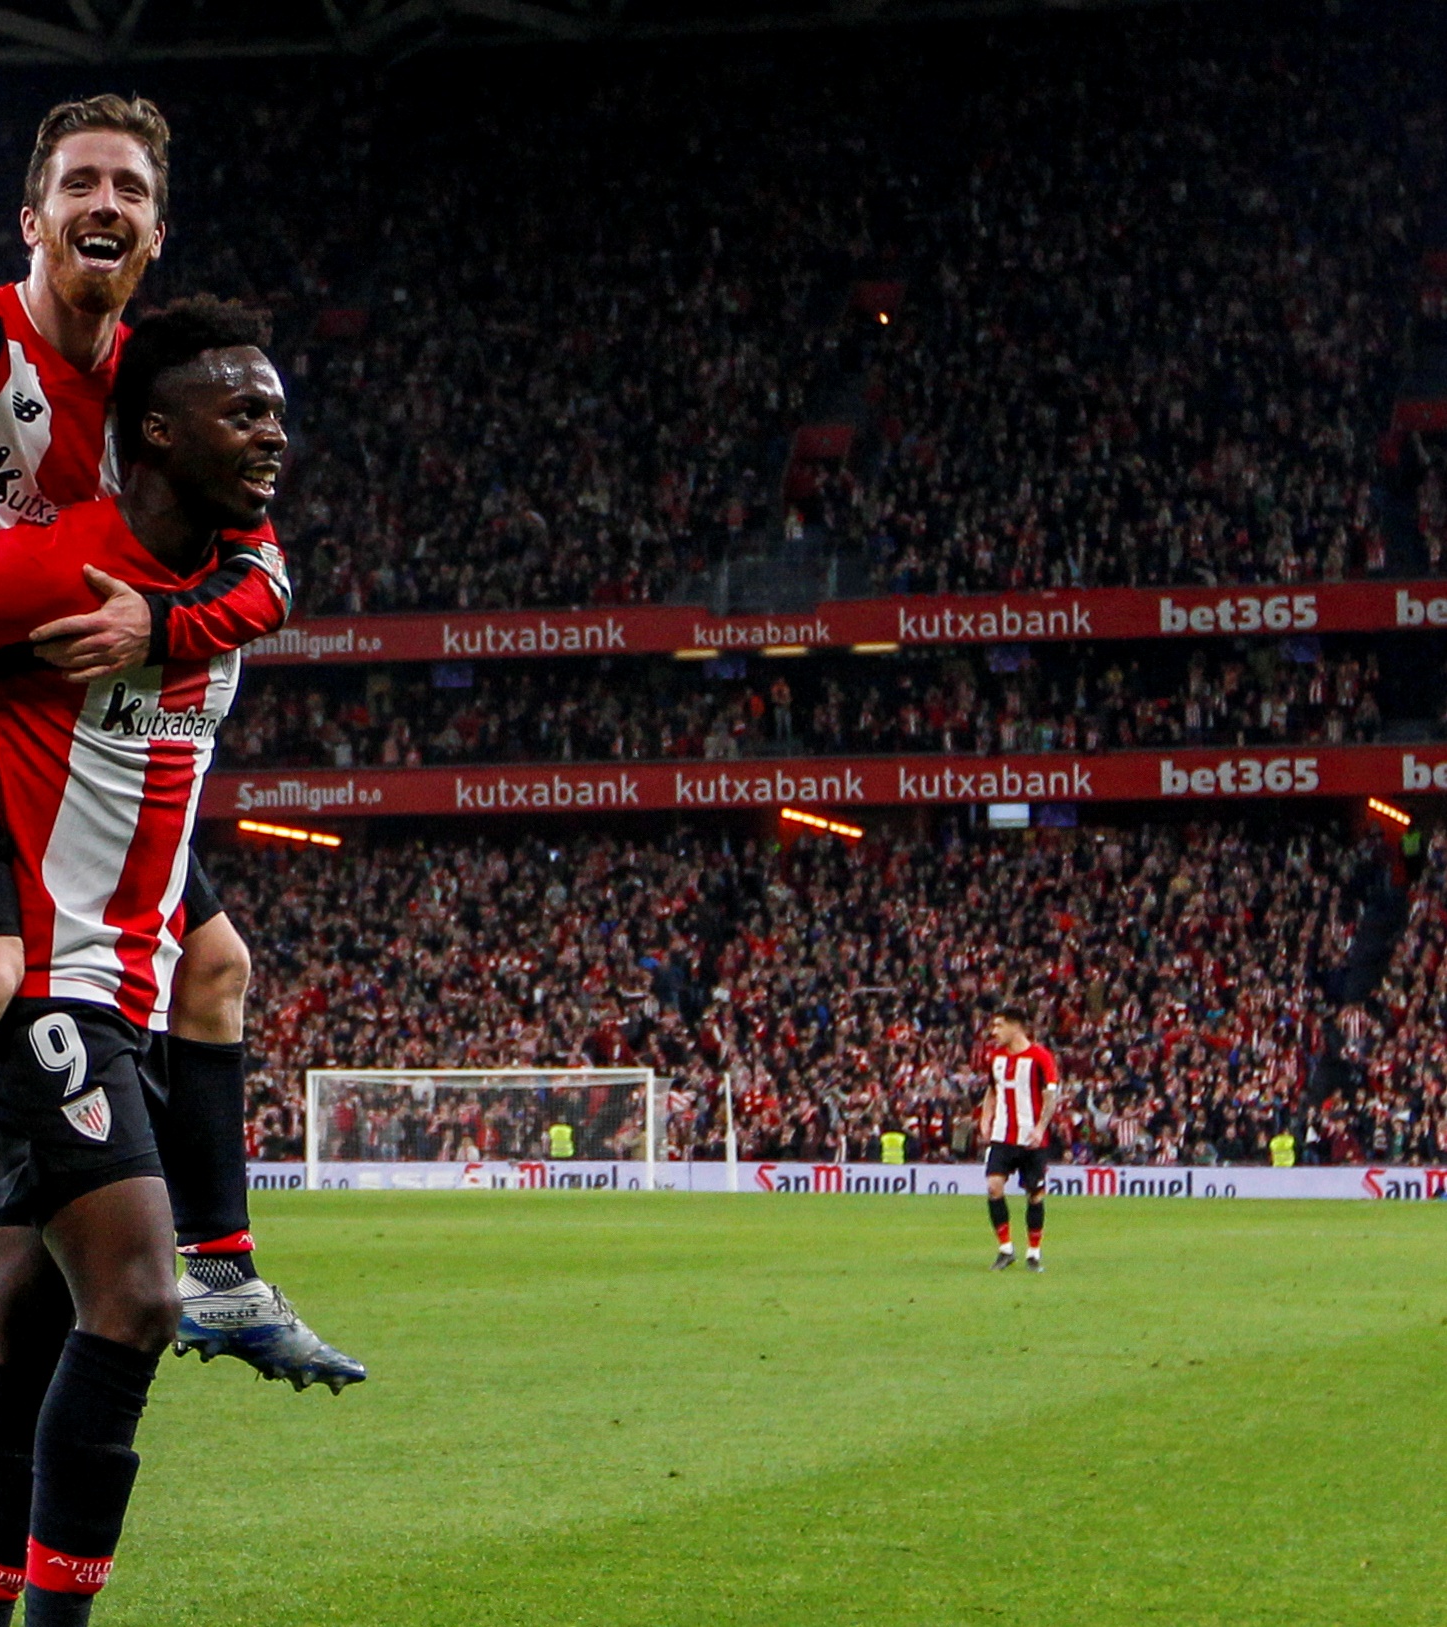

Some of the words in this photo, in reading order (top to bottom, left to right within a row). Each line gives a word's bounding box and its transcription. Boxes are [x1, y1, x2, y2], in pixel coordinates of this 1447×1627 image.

[899, 602, 1092, 640] kutxabank
[1160, 595, 1318, 632] bet365
[443, 617, 626, 654] kutxabank
[693, 620, 830, 647] kutxabank
[456, 774, 639, 808] kutxabank
[675, 768, 863, 803] kutxabank
[899, 763, 1092, 798] kutxabank
[1160, 758, 1319, 794] bet365
[29, 1012, 88, 1097] 9
[1046, 1166, 1194, 1196] anMiguel
